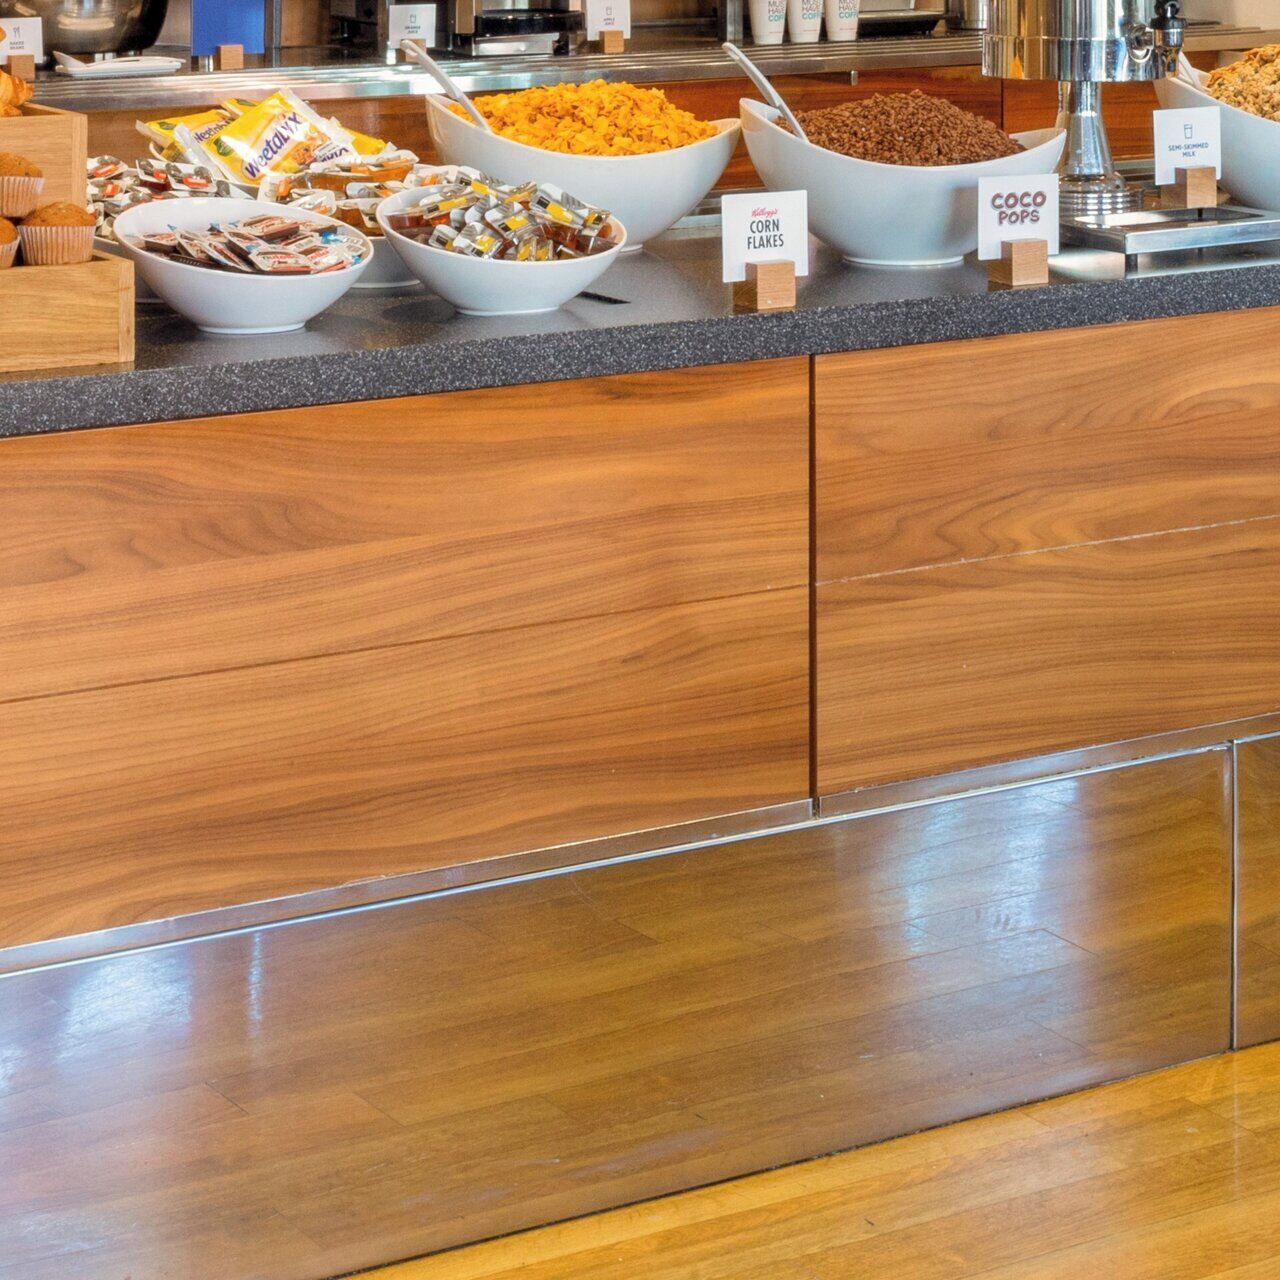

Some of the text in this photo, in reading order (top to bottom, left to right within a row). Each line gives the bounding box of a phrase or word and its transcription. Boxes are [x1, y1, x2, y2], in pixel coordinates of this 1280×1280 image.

[1168, 142, 1209, 151] SEMI-SKIMMED
[991, 190, 1047, 210] COCO
[998, 209, 1040, 225] POPS
[750, 218, 780, 234] CORN
[747, 233, 784, 250] FLAKES
